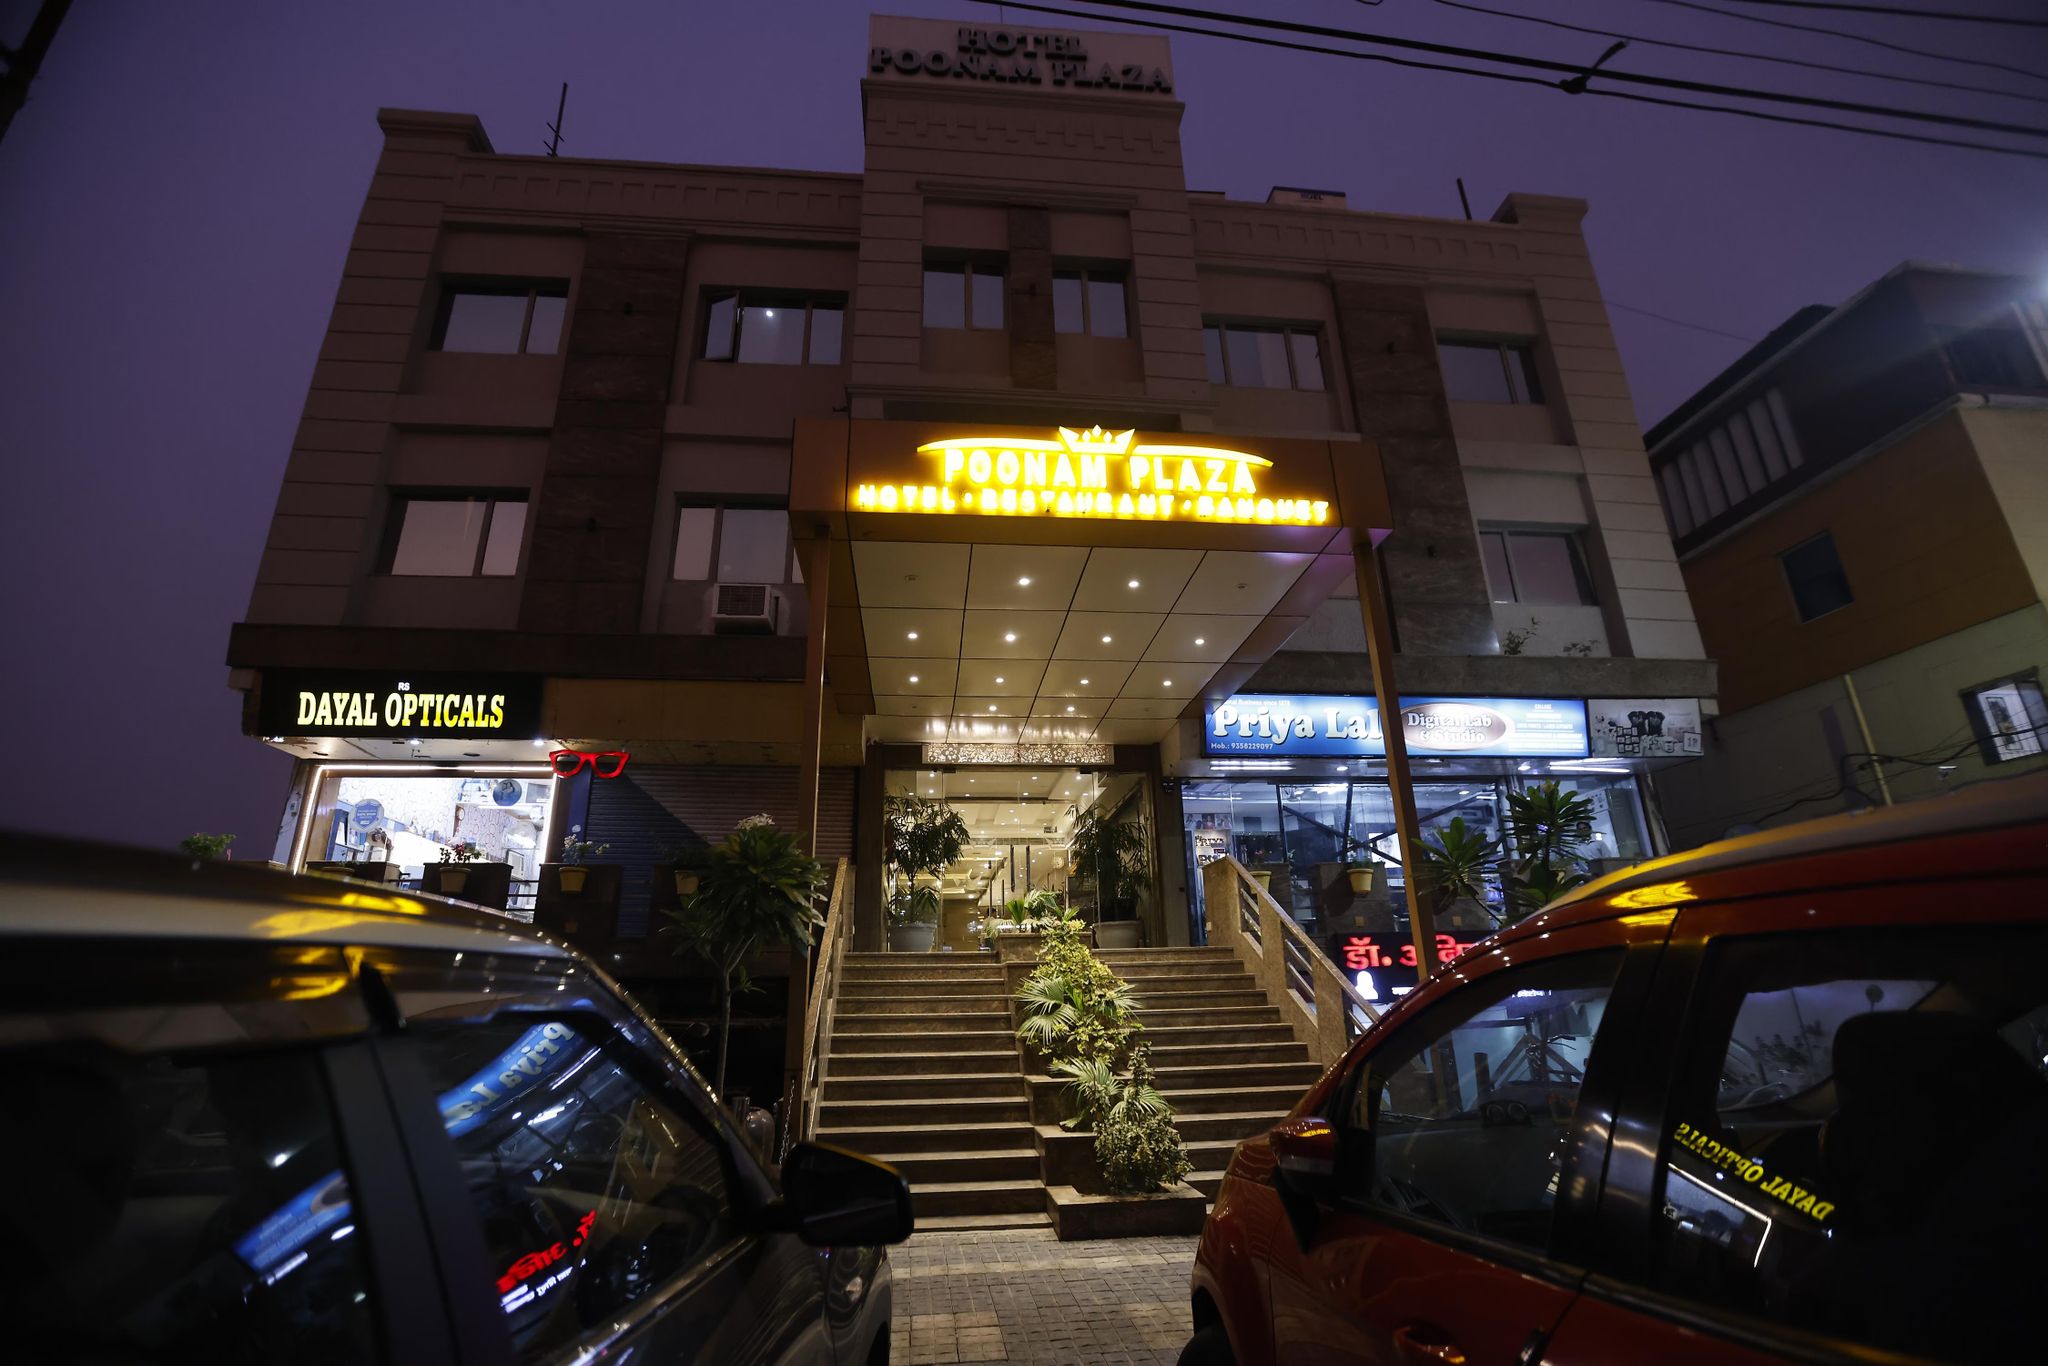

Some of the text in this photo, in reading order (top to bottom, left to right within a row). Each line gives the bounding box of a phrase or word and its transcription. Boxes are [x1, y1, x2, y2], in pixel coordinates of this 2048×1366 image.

[958, 27, 1088, 61] HOTEL
[871, 47, 1172, 94] POONAM PLAZA
[943, 447, 1257, 494] POONAM PLAZA
[858, 484, 1330, 523] HOTEL RESTAURANT BANQUET
[397, 681, 411, 692] RS
[297, 691, 505, 728] DAYAL OPTICALS
[1212, 706, 1383, 745] Priya Lal
[1464, 713, 1493, 728] Lab
[1231, 743, 1274, 751] 9358229097
[1419, 729, 1487, 744] & Studio
[1343, 936, 1393, 970] डॉ.
